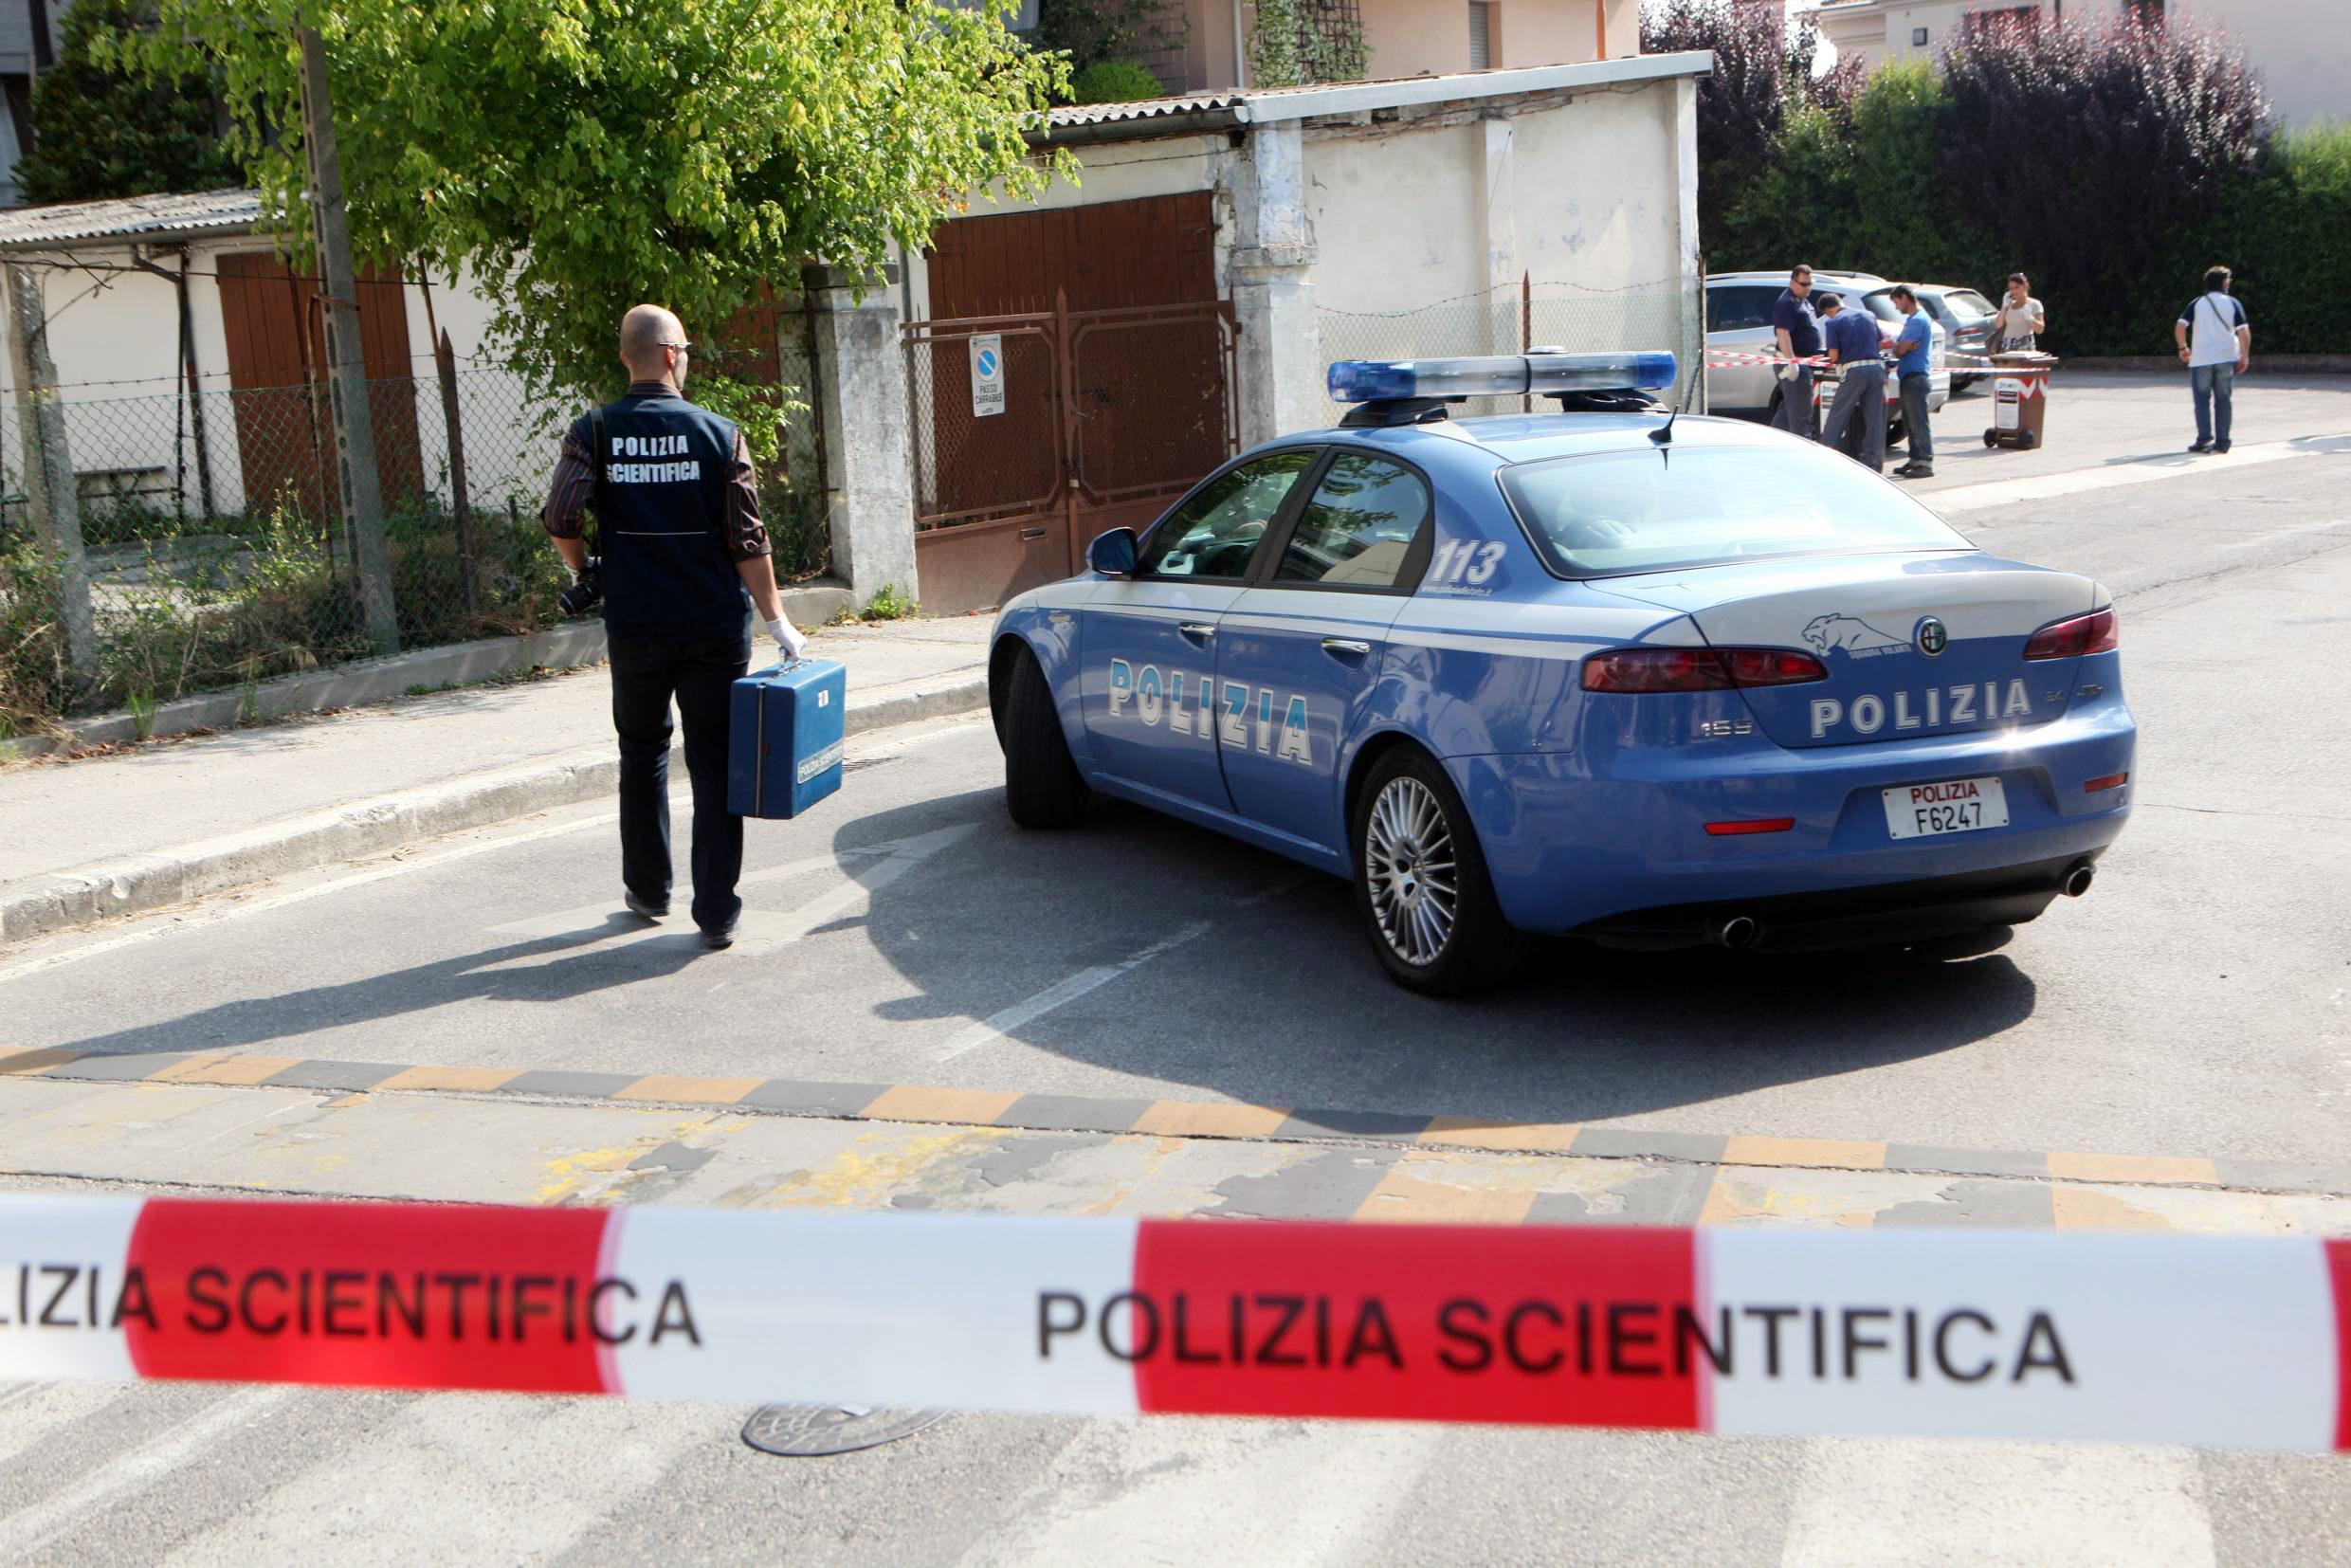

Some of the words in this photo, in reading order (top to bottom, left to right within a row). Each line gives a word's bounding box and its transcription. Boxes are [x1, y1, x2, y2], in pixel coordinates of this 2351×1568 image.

[979, 384, 997, 393] PASSO
[611, 435, 689, 456] POLIZIA
[1430, 538, 1507, 585] 113
[1109, 658, 1312, 766] POLIZIA
[1811, 679, 2032, 738] POLIZIA
[1910, 782, 1979, 804] POLIZIA
[1915, 802, 1981, 833] F6247
[184, 1267, 703, 1347] SCIENTIFICA
[1037, 1290, 1406, 1371] POLIZIA
[1434, 1296, 2078, 1387] SCIENTIFICA
